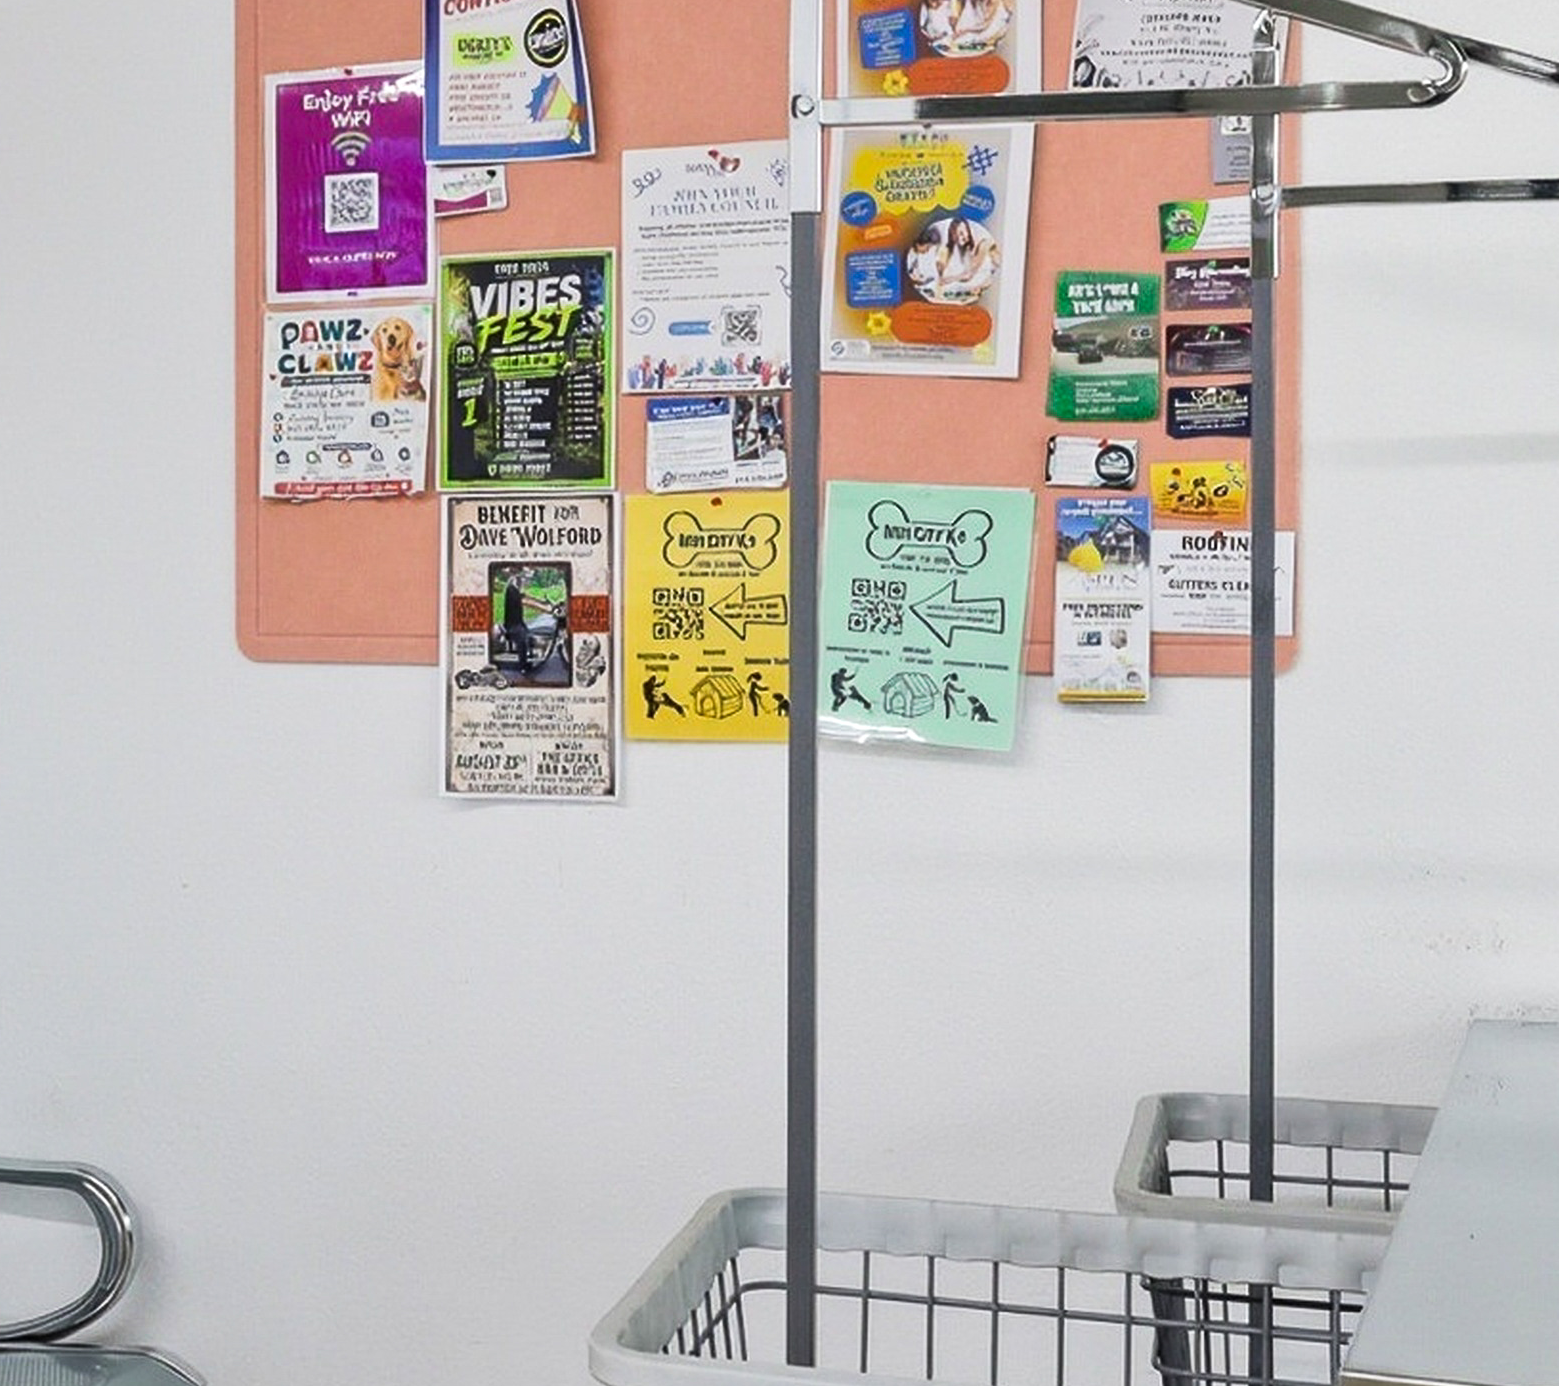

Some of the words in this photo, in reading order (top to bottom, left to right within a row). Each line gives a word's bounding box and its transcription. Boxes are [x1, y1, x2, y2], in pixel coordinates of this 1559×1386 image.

[302, 88, 354, 113] Enjoy
[468, 273, 582, 321] VIBES
[280, 318, 363, 350] PAWZ
[476, 304, 583, 352] FEST
[277, 350, 374, 374] CLAWZ
[477, 504, 546, 525] BENEFIT
[509, 526, 602, 549] WOLFORD
[1181, 535, 1250, 552] ROOFIN
